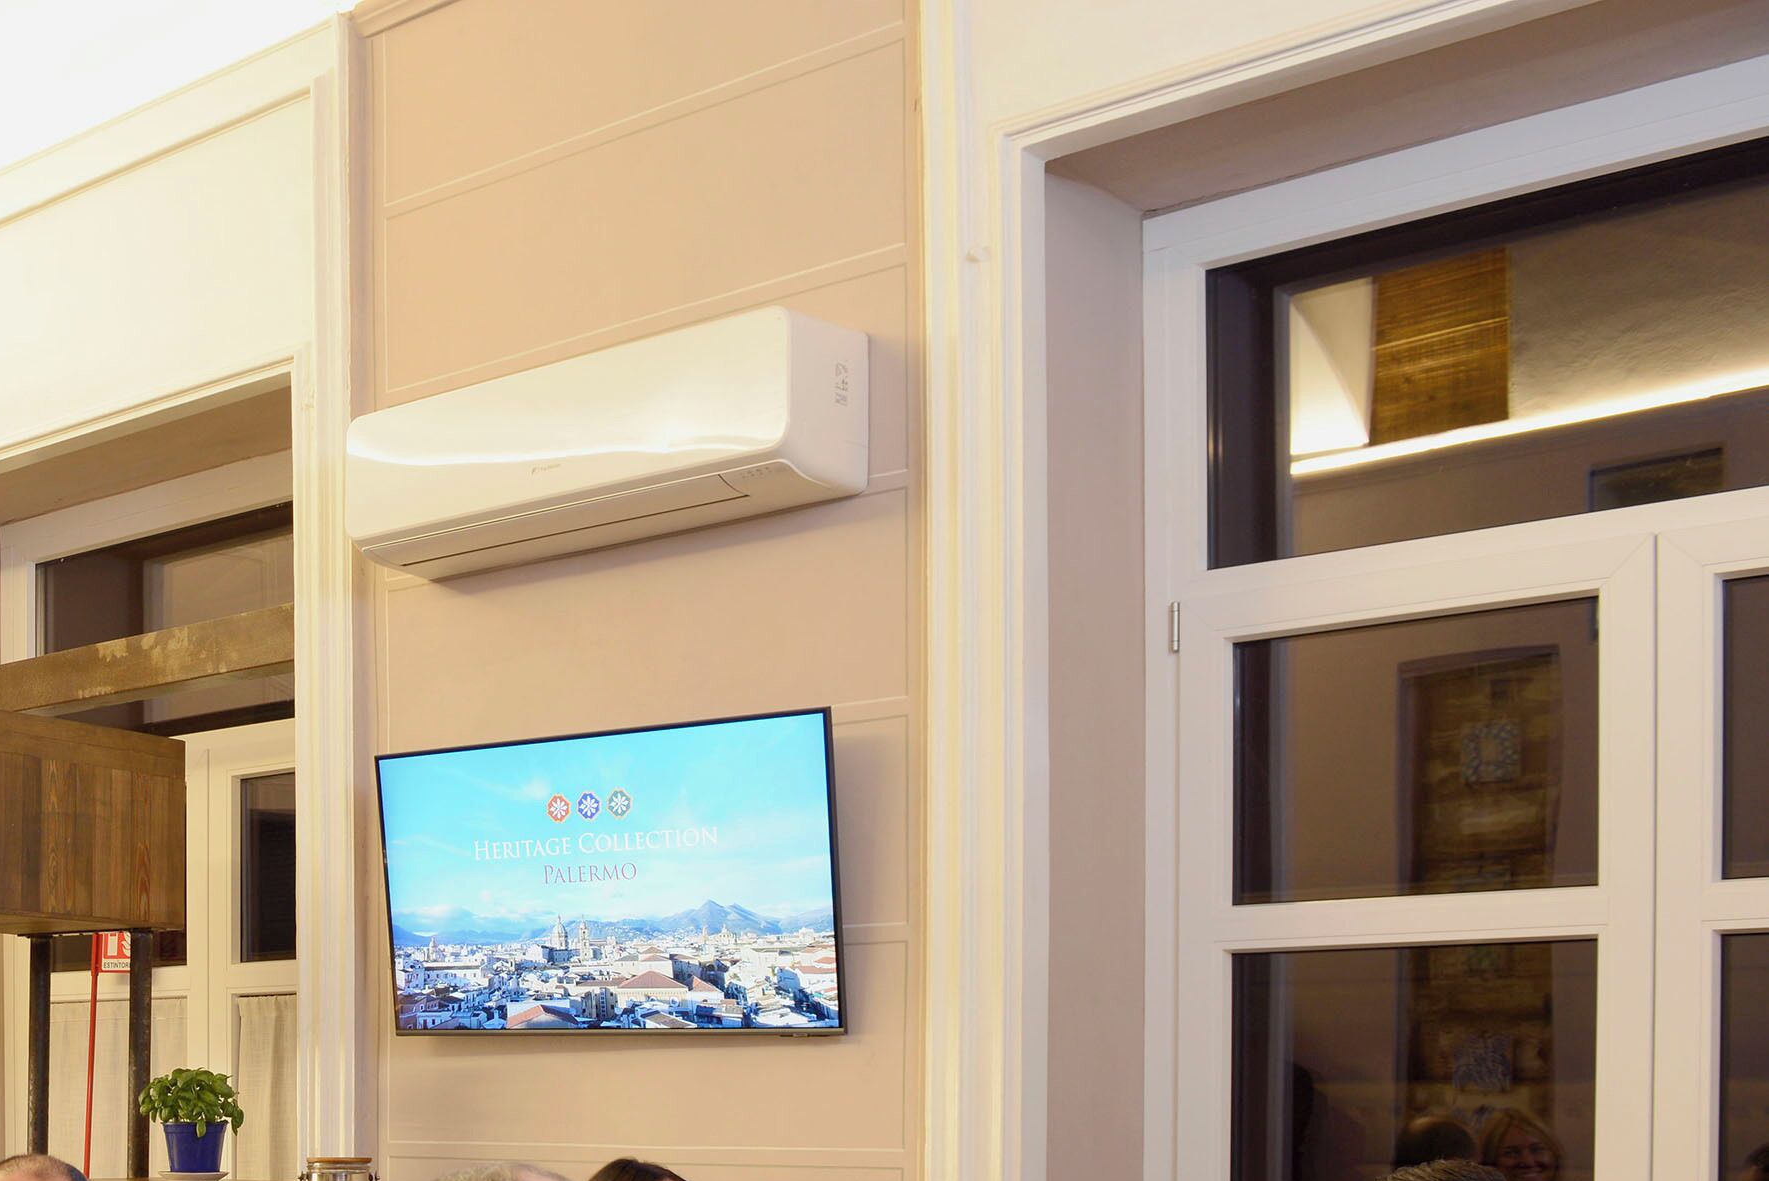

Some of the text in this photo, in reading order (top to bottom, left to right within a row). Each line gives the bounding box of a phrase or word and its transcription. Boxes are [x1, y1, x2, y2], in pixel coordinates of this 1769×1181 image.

[474, 826, 718, 861] HERITAGE COLLECTION
[543, 862, 637, 885] PALERMO
